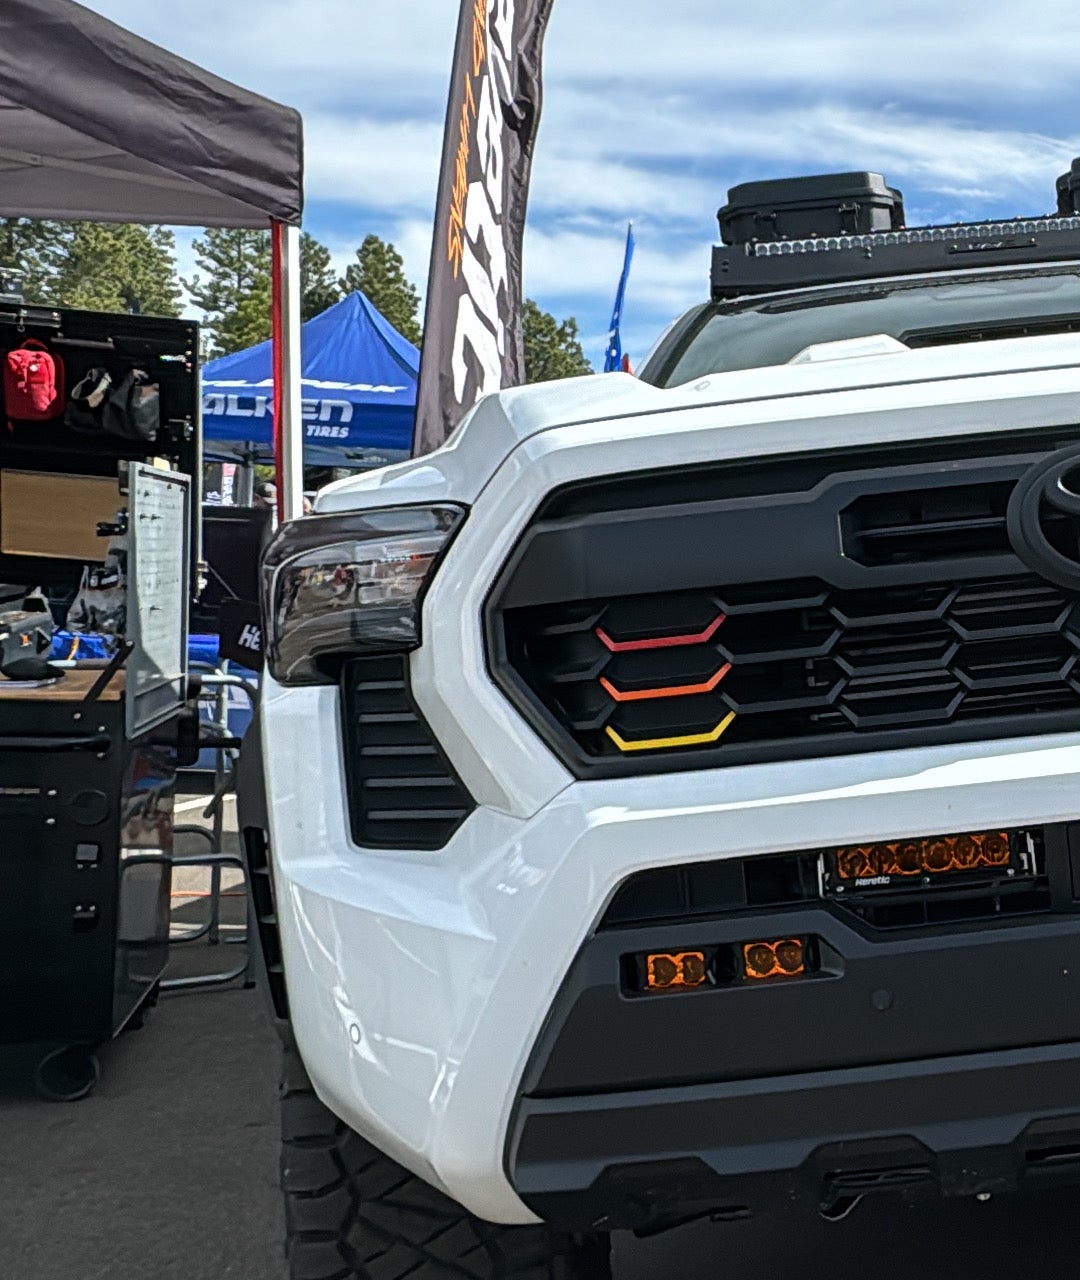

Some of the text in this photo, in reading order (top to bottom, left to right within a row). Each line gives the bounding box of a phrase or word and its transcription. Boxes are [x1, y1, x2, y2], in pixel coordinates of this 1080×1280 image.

[202, 393, 353, 422] ALKEN
[306, 425, 349, 439] TIRES
[855, 876, 891, 887] Heretic
